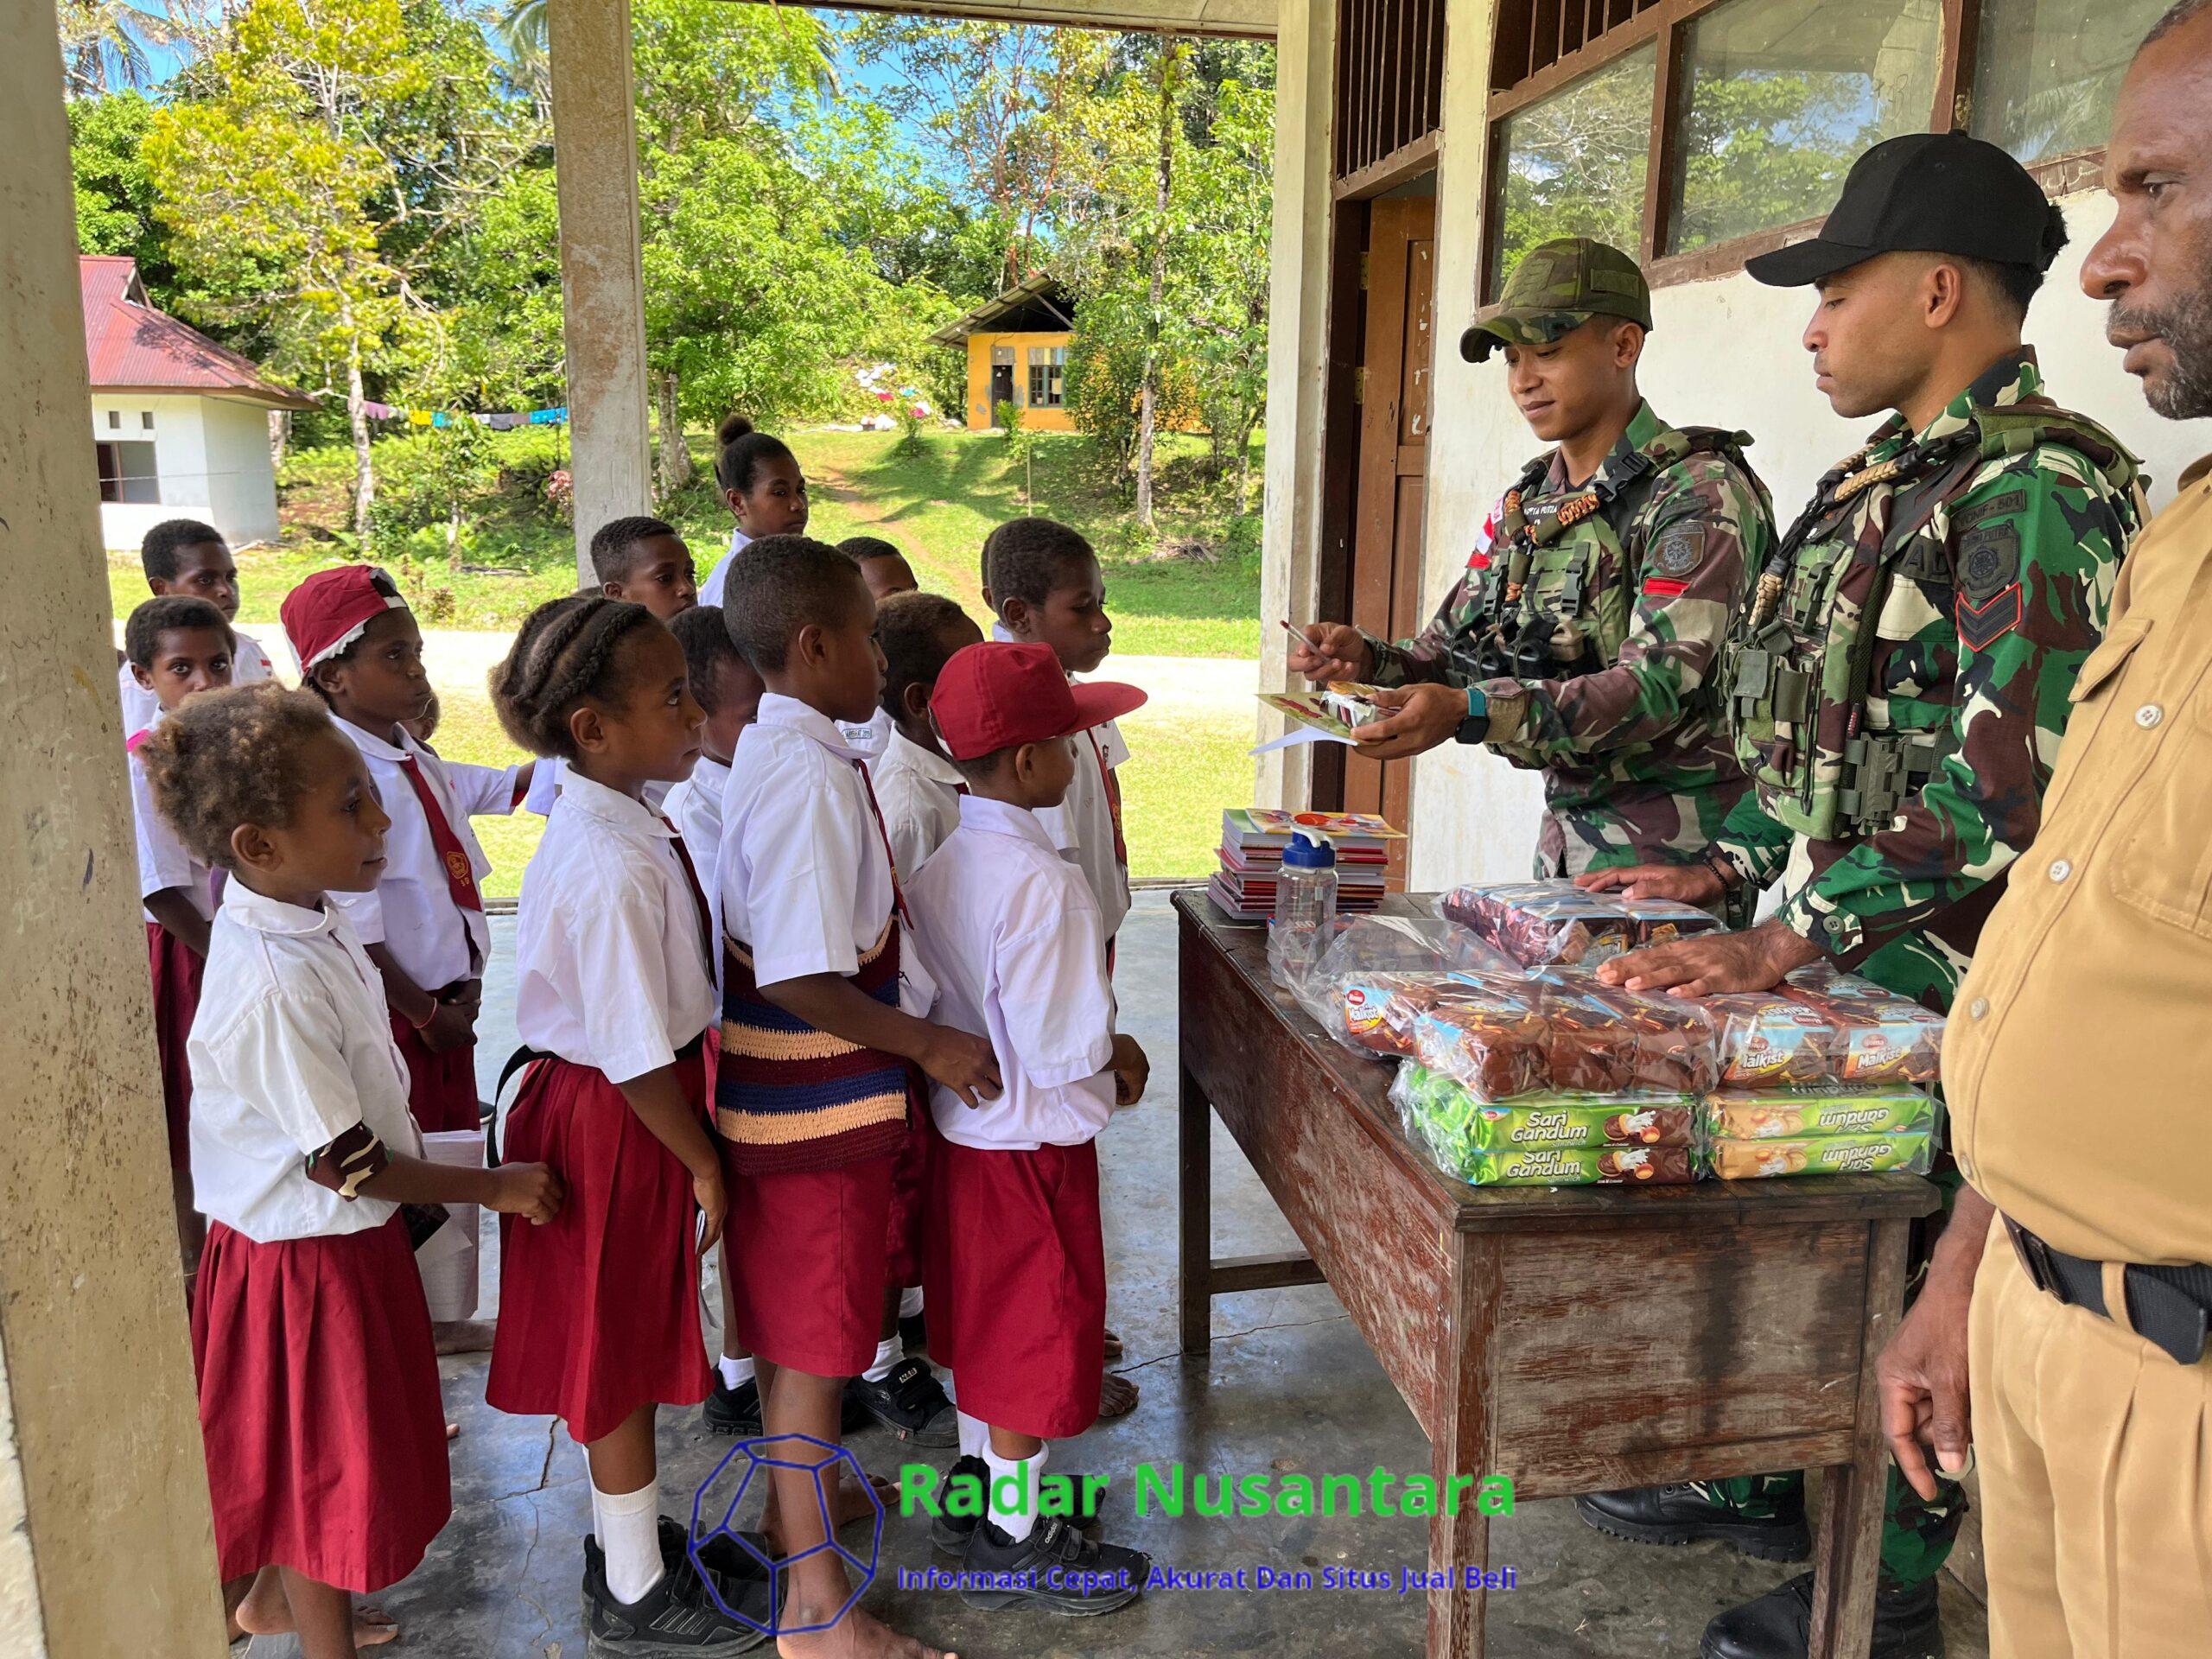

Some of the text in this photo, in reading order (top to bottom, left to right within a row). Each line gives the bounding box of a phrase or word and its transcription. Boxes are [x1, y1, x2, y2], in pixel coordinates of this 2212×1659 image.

[1527, 1109, 1567, 1128] Sari
[1819, 1109, 1890, 1127] Gandum
[1510, 1122, 1588, 1142] Gandum
[1821, 1144, 1892, 1162] Gandum
[1506, 1158, 1581, 1178] Gandum
[1837, 1157, 1875, 1172] Sari
